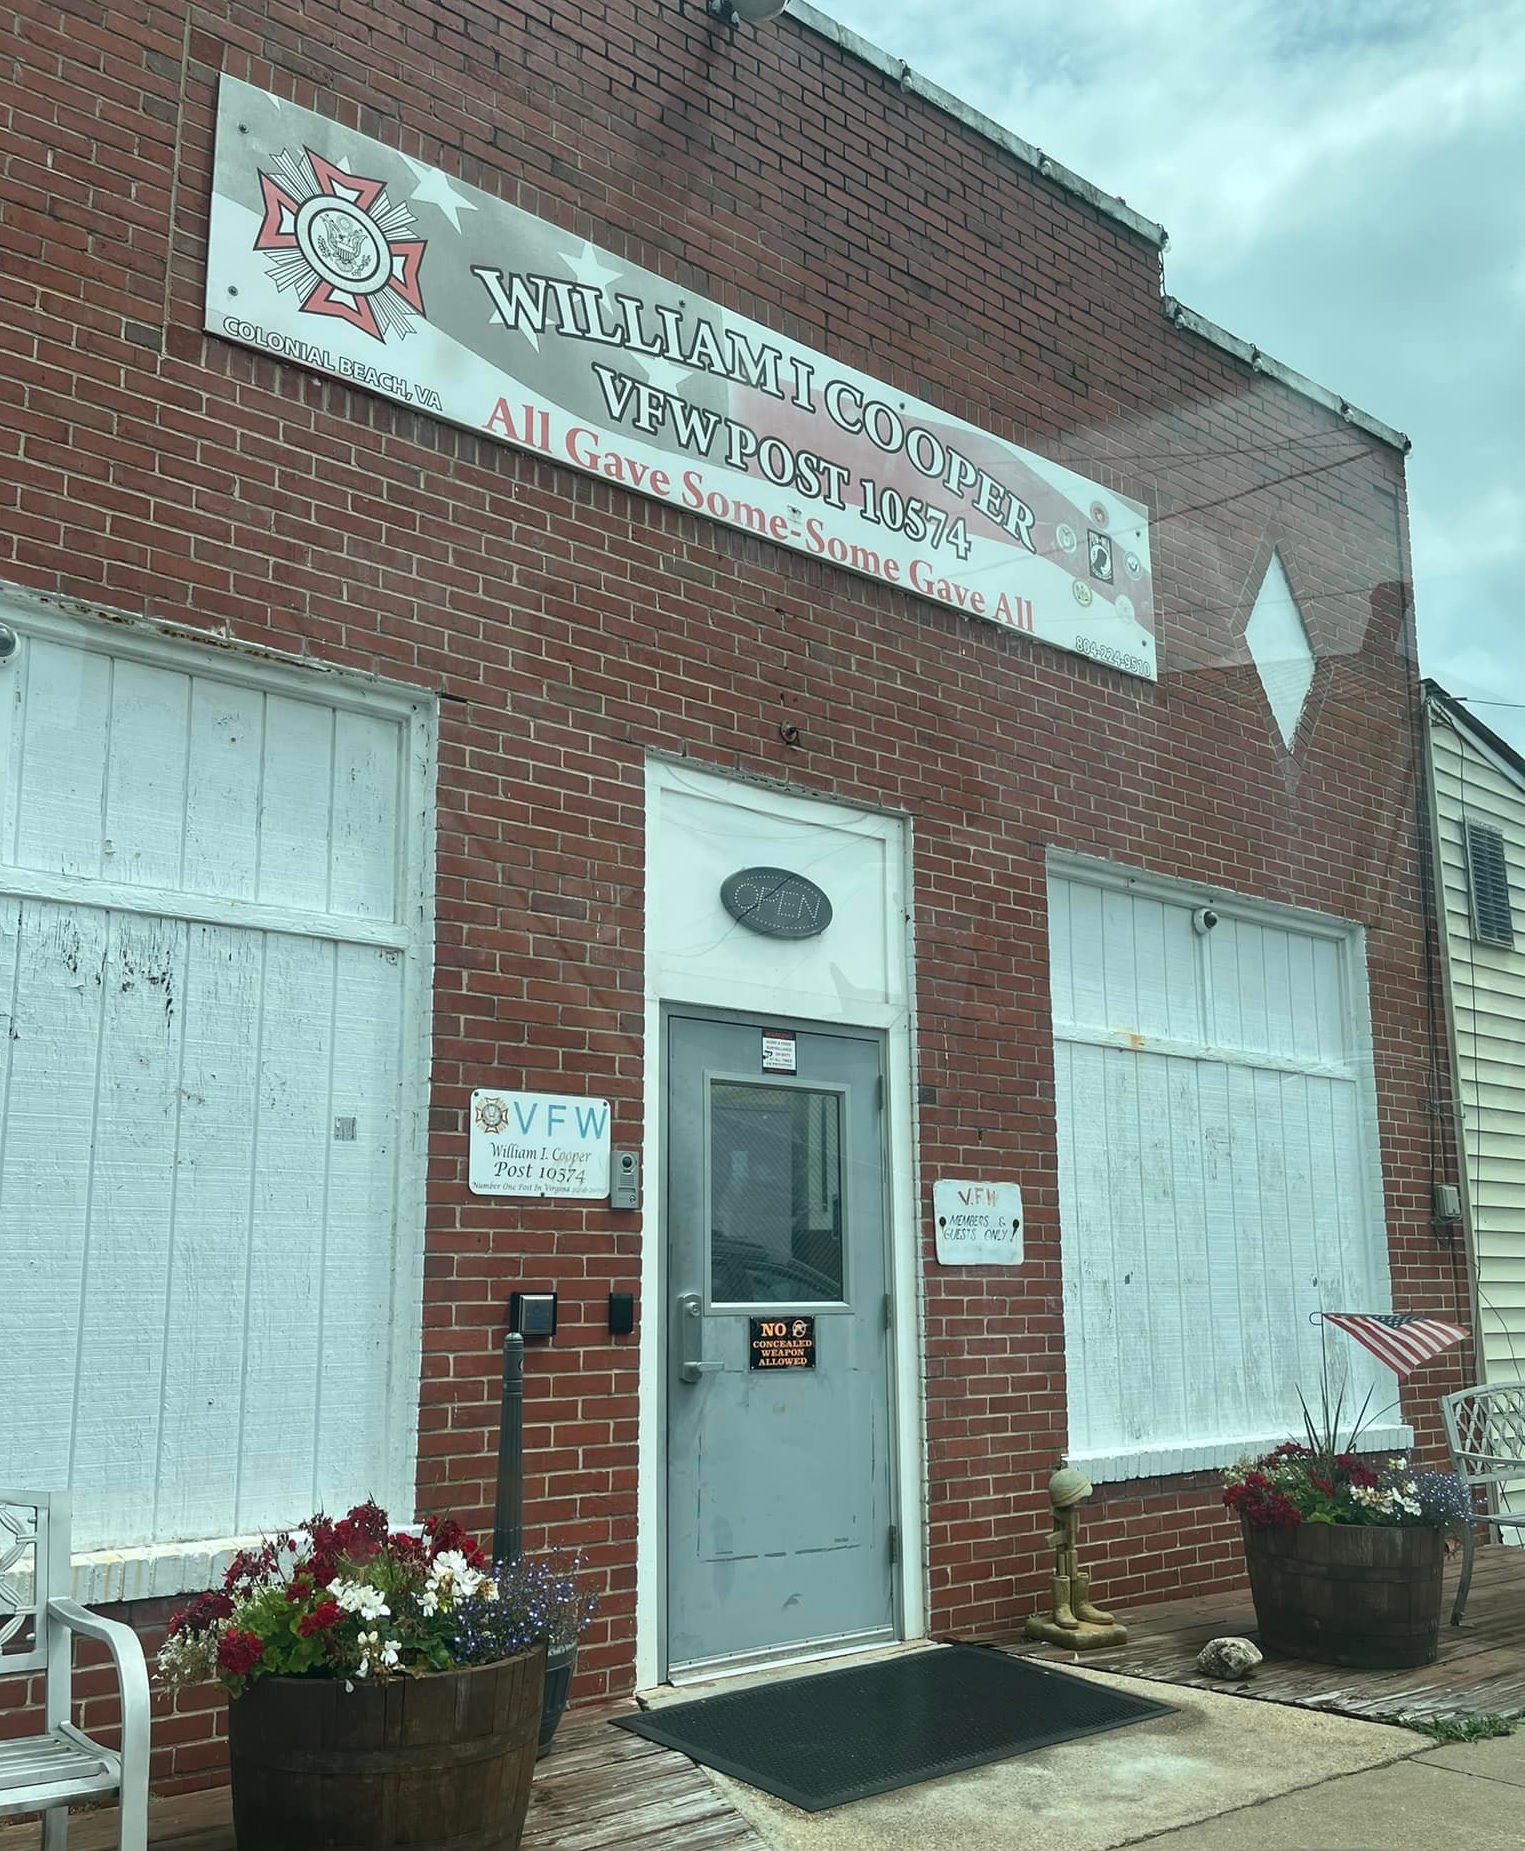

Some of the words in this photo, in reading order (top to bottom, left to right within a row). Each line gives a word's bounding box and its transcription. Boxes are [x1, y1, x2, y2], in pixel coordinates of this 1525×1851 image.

[222, 316, 336, 372] COLONIAL
[338, 356, 414, 401] BEACH,
[414, 384, 443, 411] VA
[470, 265, 785, 401] WILLIAM
[790, 356, 816, 414] I
[824, 379, 1037, 554] COOPER
[591, 361, 722, 457] VFW
[725, 416, 850, 511] POST
[860, 478, 972, 561] 10574
[481, 396, 553, 454] All
[564, 426, 671, 496] Gave
[681, 470, 901, 582] Some-Some
[908, 559, 987, 614] Gave
[992, 591, 1036, 633] All
[1075, 635, 1151, 678] 804-224-9510
[734, 882, 821, 921] OPEN
[513, 1101, 608, 1140] VFW
[489, 1142, 537, 1161] William
[552, 1147, 592, 1167] Cooper
[493, 1161, 533, 1179] Post
[540, 1167, 587, 1186] 10574
[949, 1215, 989, 1228] MEMBERS
[943, 1228, 977, 1241] GUESTS
[761, 1323, 787, 1336] NO
[753, 1340, 812, 1348] CONCEALED
[761, 1349, 804, 1357] WEAPON
[759, 1358, 807, 1366] ALLOWED
